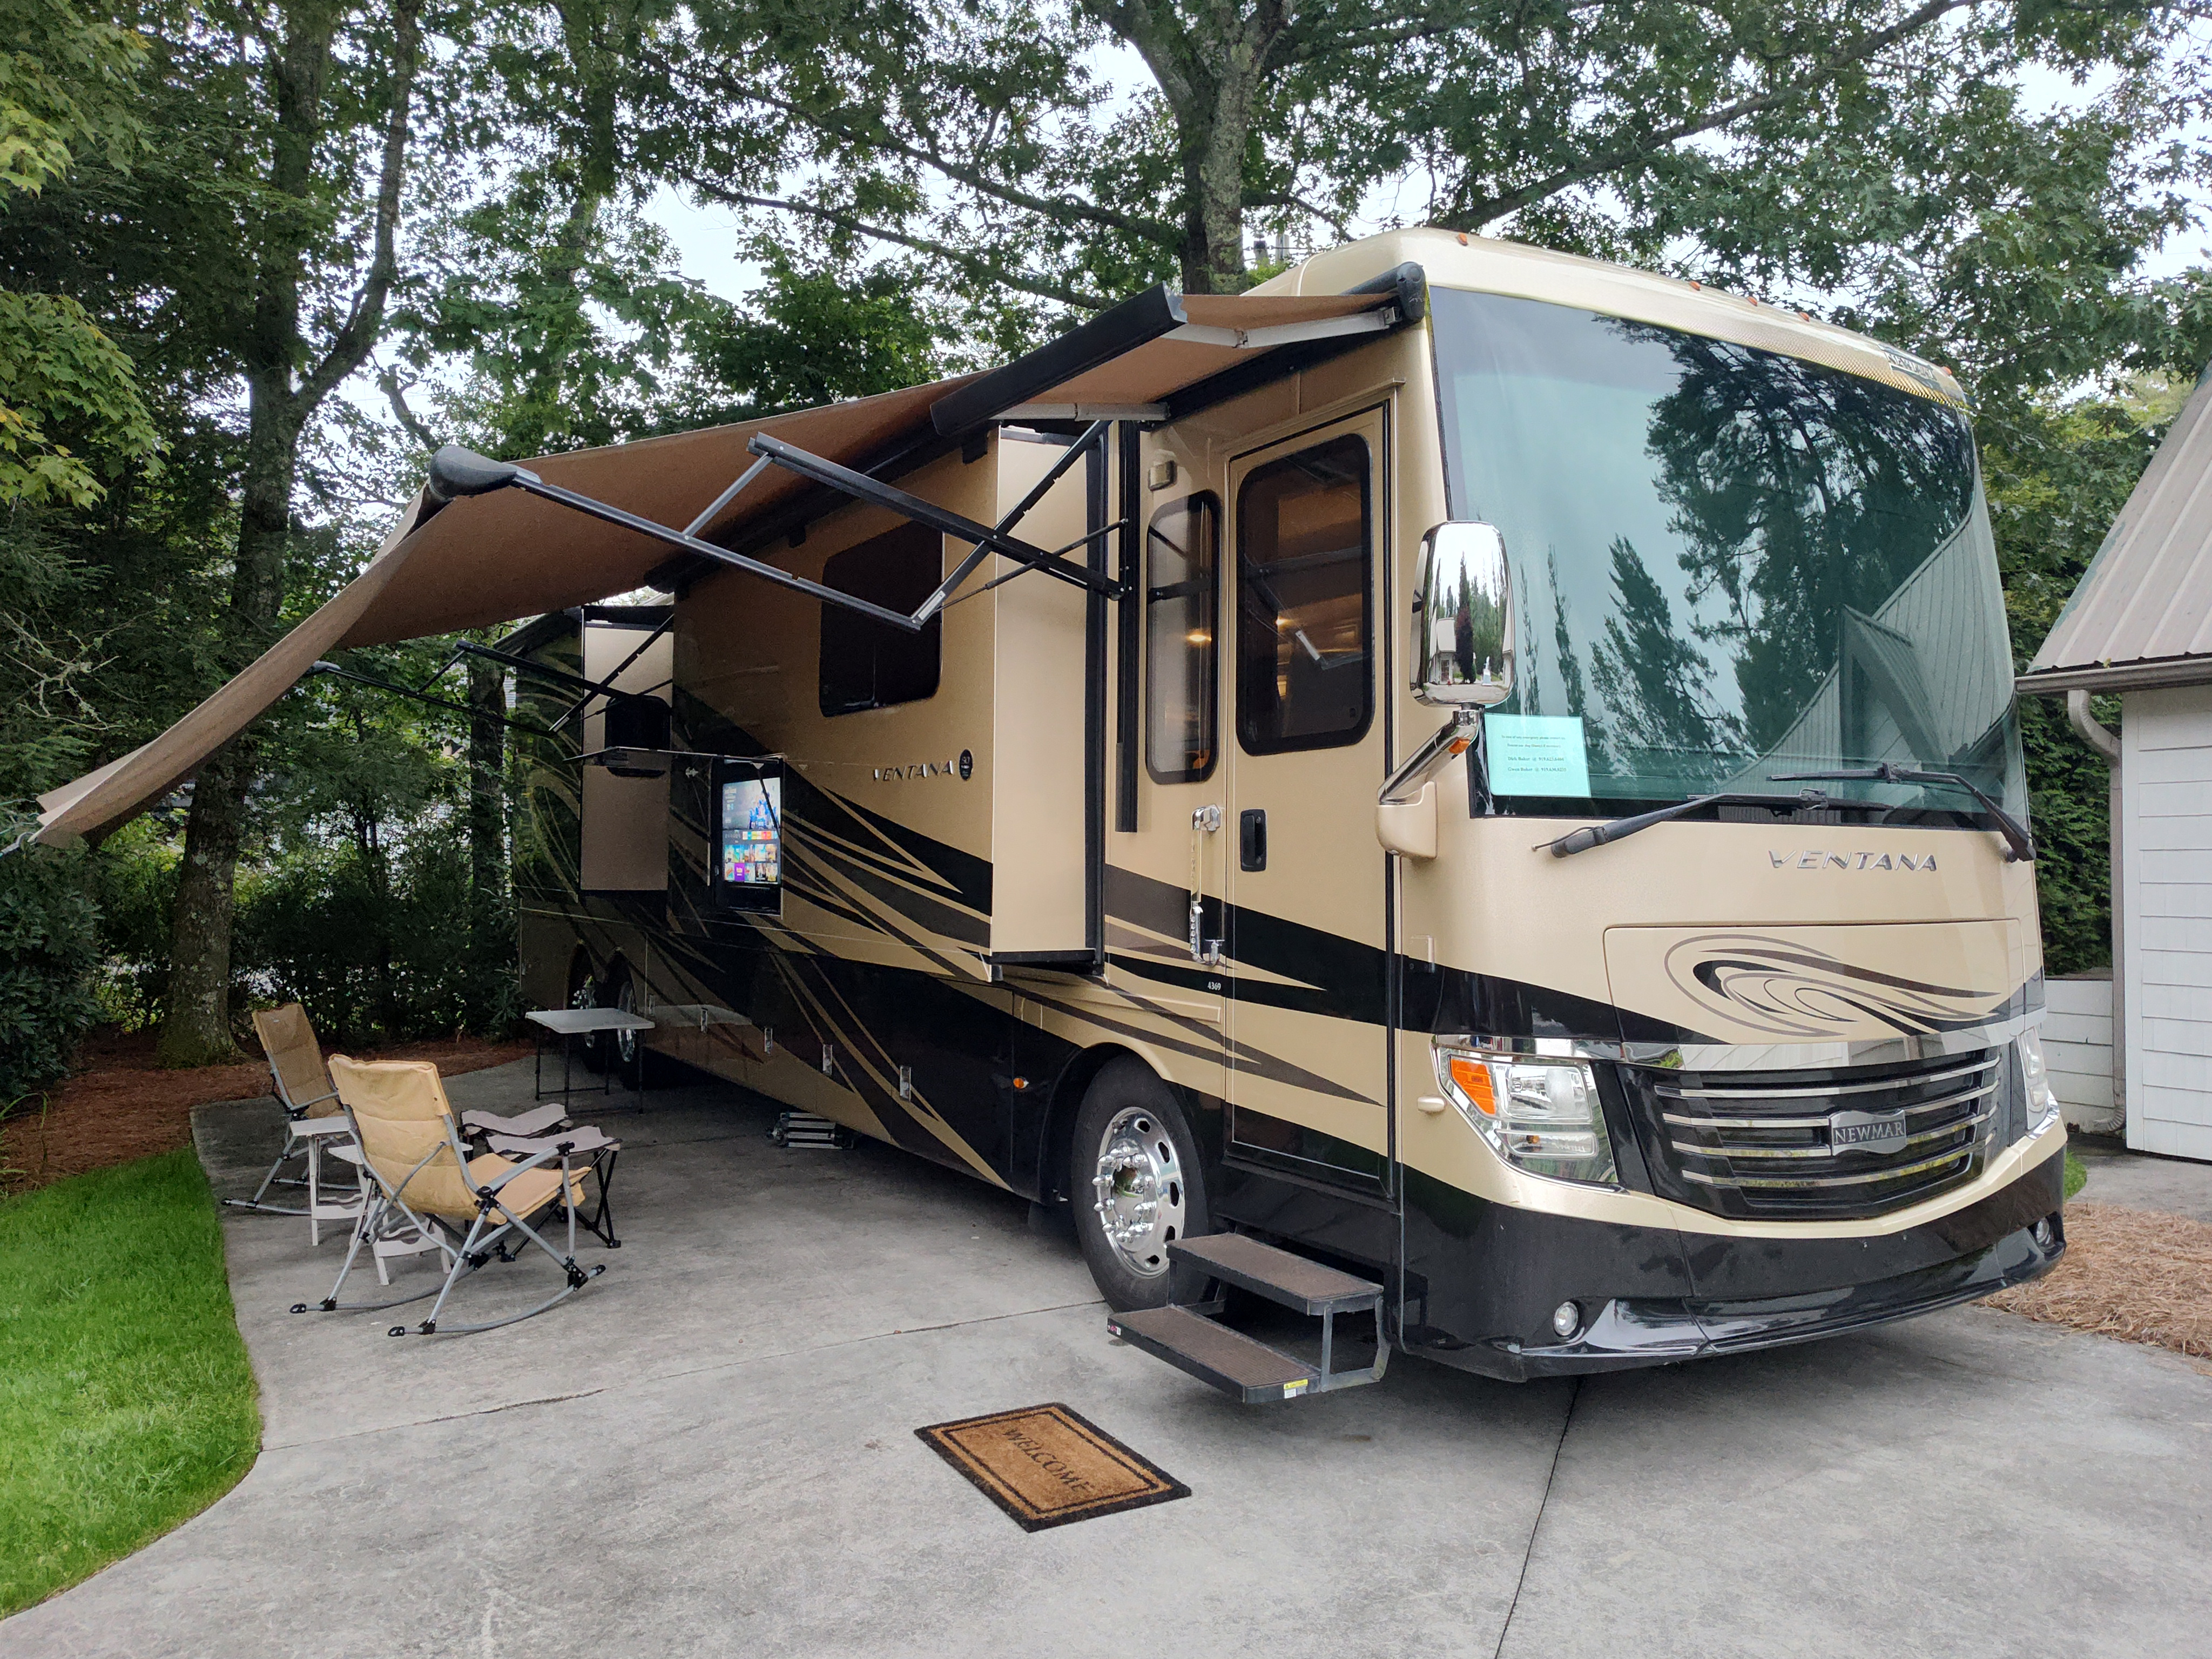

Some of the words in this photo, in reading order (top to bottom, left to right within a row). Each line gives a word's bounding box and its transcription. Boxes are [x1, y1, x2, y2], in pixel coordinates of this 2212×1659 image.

[873, 760, 954, 781] VENTANA
[1768, 849, 1937, 872] VENTANA
[1208, 981, 1221, 990] 4369
[1835, 1122, 1905, 1144] NEWMAR
[1002, 1428, 1094, 1492] WELCOME
